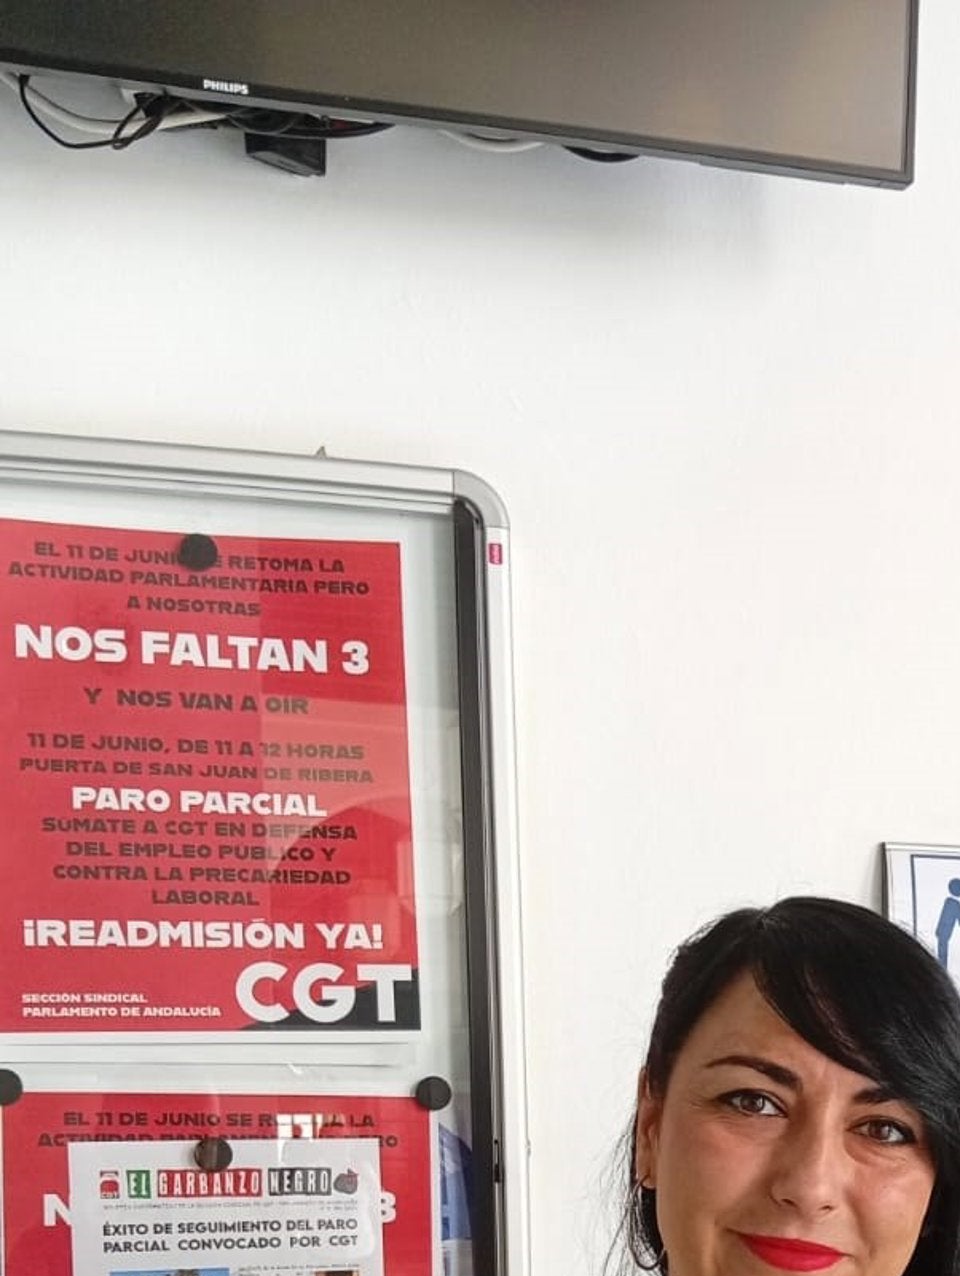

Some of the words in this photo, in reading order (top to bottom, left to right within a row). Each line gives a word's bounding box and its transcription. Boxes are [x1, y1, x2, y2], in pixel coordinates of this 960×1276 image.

[203, 78, 249, 95] PHILIPS
[35, 541, 60, 557] EL
[66, 544, 82, 559] 11
[89, 547, 118, 561] DE
[124, 549, 182, 566] JUNI
[229, 555, 314, 572] RETOMA
[319, 558, 344, 573] LA
[9, 561, 124, 583] ACTIVIDAD
[130, 571, 308, 594] PARLAMENTARIA
[314, 580, 369, 595] PERO
[127, 596, 141, 610] A
[147, 597, 261, 616] NOSOTRAS
[15, 623, 127, 664] NOS
[141, 629, 328, 674] FALTAN
[341, 640, 370, 675] 3
[84, 688, 102, 704] Y
[117, 689, 171, 708] NOS
[179, 692, 233, 711] VAN
[241, 695, 258, 712] A
[266, 697, 308, 714] OIR
[27, 733, 45, 748] 11
[53, 734, 84, 749] DE
[92, 736, 169, 754] JUNIO,
[178, 739, 208, 754] DE
[215, 740, 233, 755] 11
[240, 741, 254, 757] A
[259, 743, 281, 758] 12
[287, 744, 364, 760] HORAS
[19, 758, 106, 774] PUERTA
[113, 762, 142, 775] DE
[148, 763, 192, 776] SAN
[200, 765, 257, 779] JUAN
[265, 768, 291, 781] DE
[298, 769, 373, 783] RIBERA
[72, 786, 171, 812] PARO
[180, 790, 327, 817] PARCIAL
[143, 821, 158, 835] A
[165, 821, 207, 836] CGT
[215, 823, 245, 837] EN
[252, 823, 357, 840] DEFENSA
[66, 841, 112, 856] DEL
[119, 843, 211, 858] EMPLEO
[322, 848, 336, 861] Y
[53, 864, 148, 881] CONTRA
[155, 867, 183, 881] LA
[189, 867, 351, 884] PRECARIEDAD
[152, 890, 260, 906] LABORAL
[23, 918, 305, 949] ¡READMISIÓN
[315, 922, 384, 950] YA!
[83, 993, 148, 1003] SINDICAL
[235, 960, 412, 1024] CGT
[23, 1006, 117, 1017] PARLAMENTO
[121, 1006, 140, 1016] DE
[64, 1112, 89, 1127] EL
[96, 1112, 113, 1126] 11
[119, 1112, 148, 1127] DE
[155, 1112, 221, 1127] JUNIO
[227, 1114, 252, 1127] SE
[129, 1172, 148, 1196] EL
[158, 1171, 260, 1197] GARBANZO
[269, 1170, 330, 1195] NEGRO
[103, 1220, 149, 1236] ÉXITO
[153, 1222, 172, 1235] DE
[178, 1219, 282, 1234] SEGUIMIENTO
[286, 1219, 313, 1231] DEL
[317, 1218, 358, 1231] PARO
[103, 1239, 170, 1253] PARCIAL
[178, 1237, 282, 1251] CONVOCADO
[290, 1236, 320, 1248] POR
[329, 1235, 358, 1247] CGT
